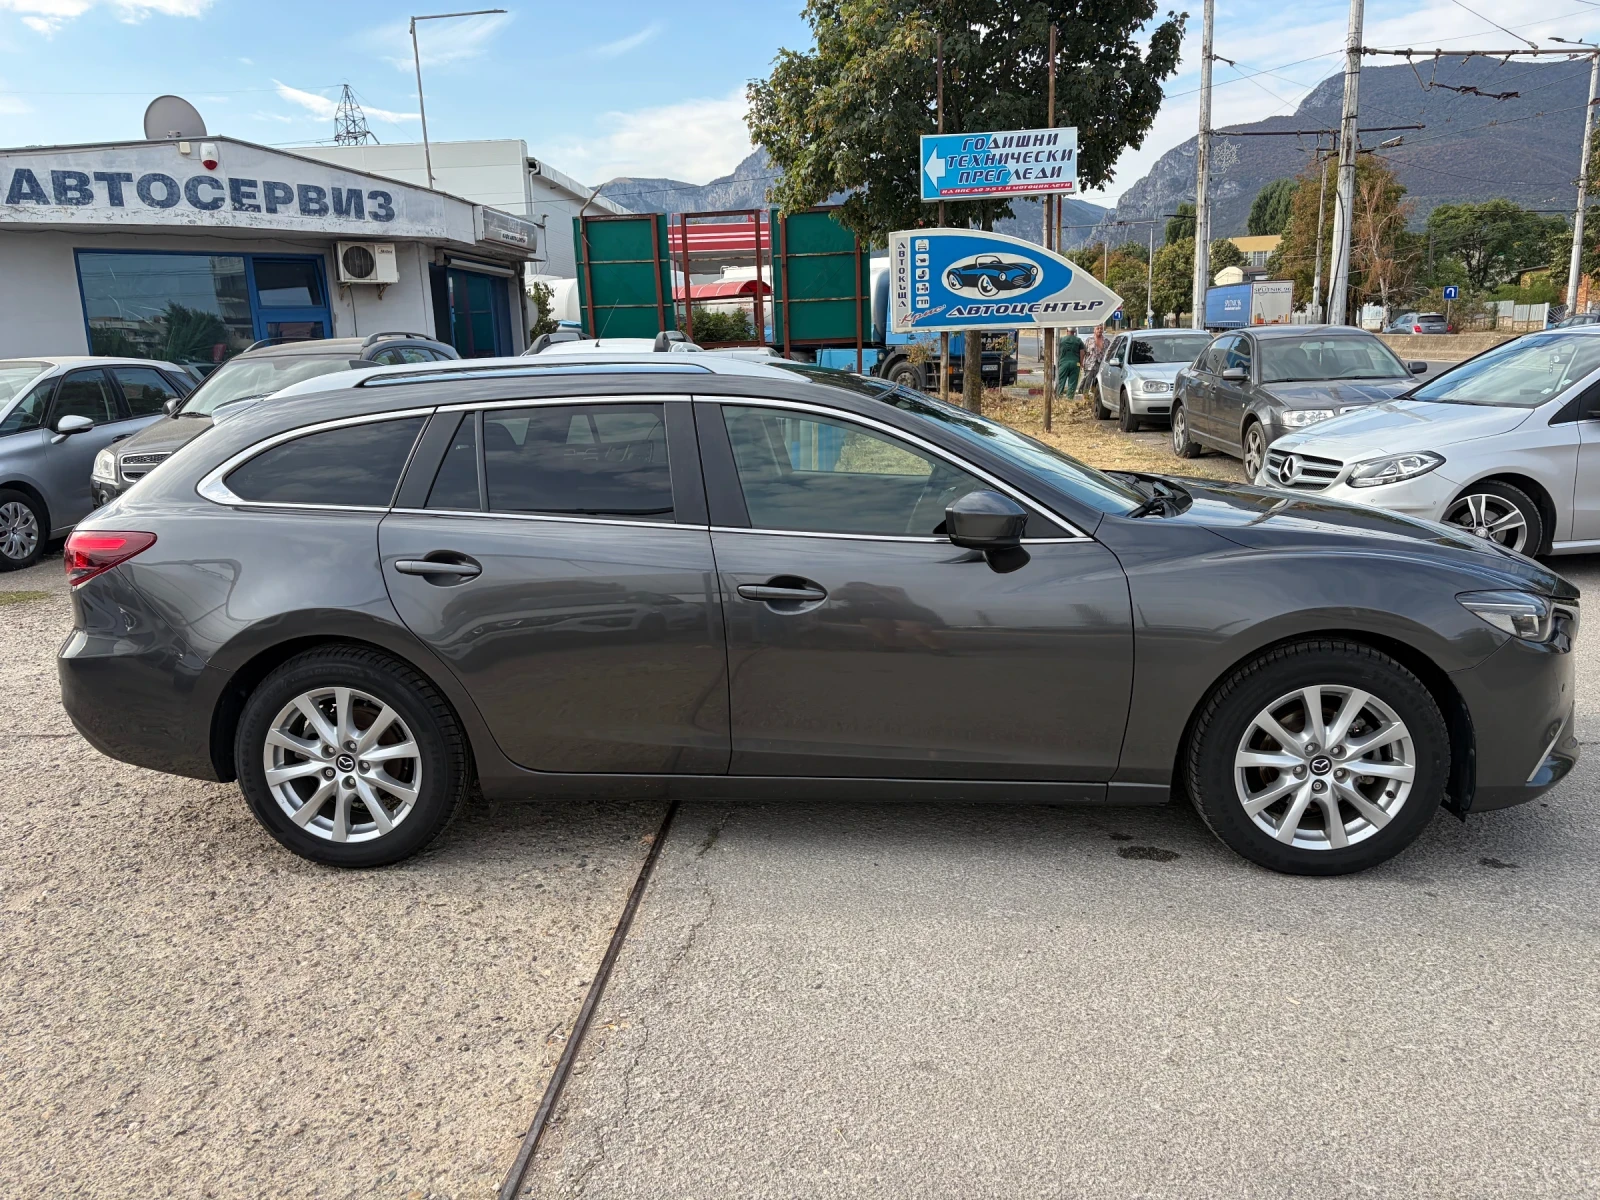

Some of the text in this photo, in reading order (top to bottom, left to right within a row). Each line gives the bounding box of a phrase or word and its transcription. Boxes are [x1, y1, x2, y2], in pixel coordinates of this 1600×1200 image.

[961, 132, 1059, 152] ГОДИШНИ
[947, 148, 1074, 169] ТЕХНИЧЕСКИ
[957, 165, 1063, 185] ПРЕГЛЕДИ
[4, 167, 395, 223] АВТОСЕРВИЗ
[1011, 182, 1071, 190] МОТОЦИКЛЕТИ
[897, 241, 908, 308] АВТОКЪЩА
[947, 300, 1104, 317] АВТОЦЕНТЪР
